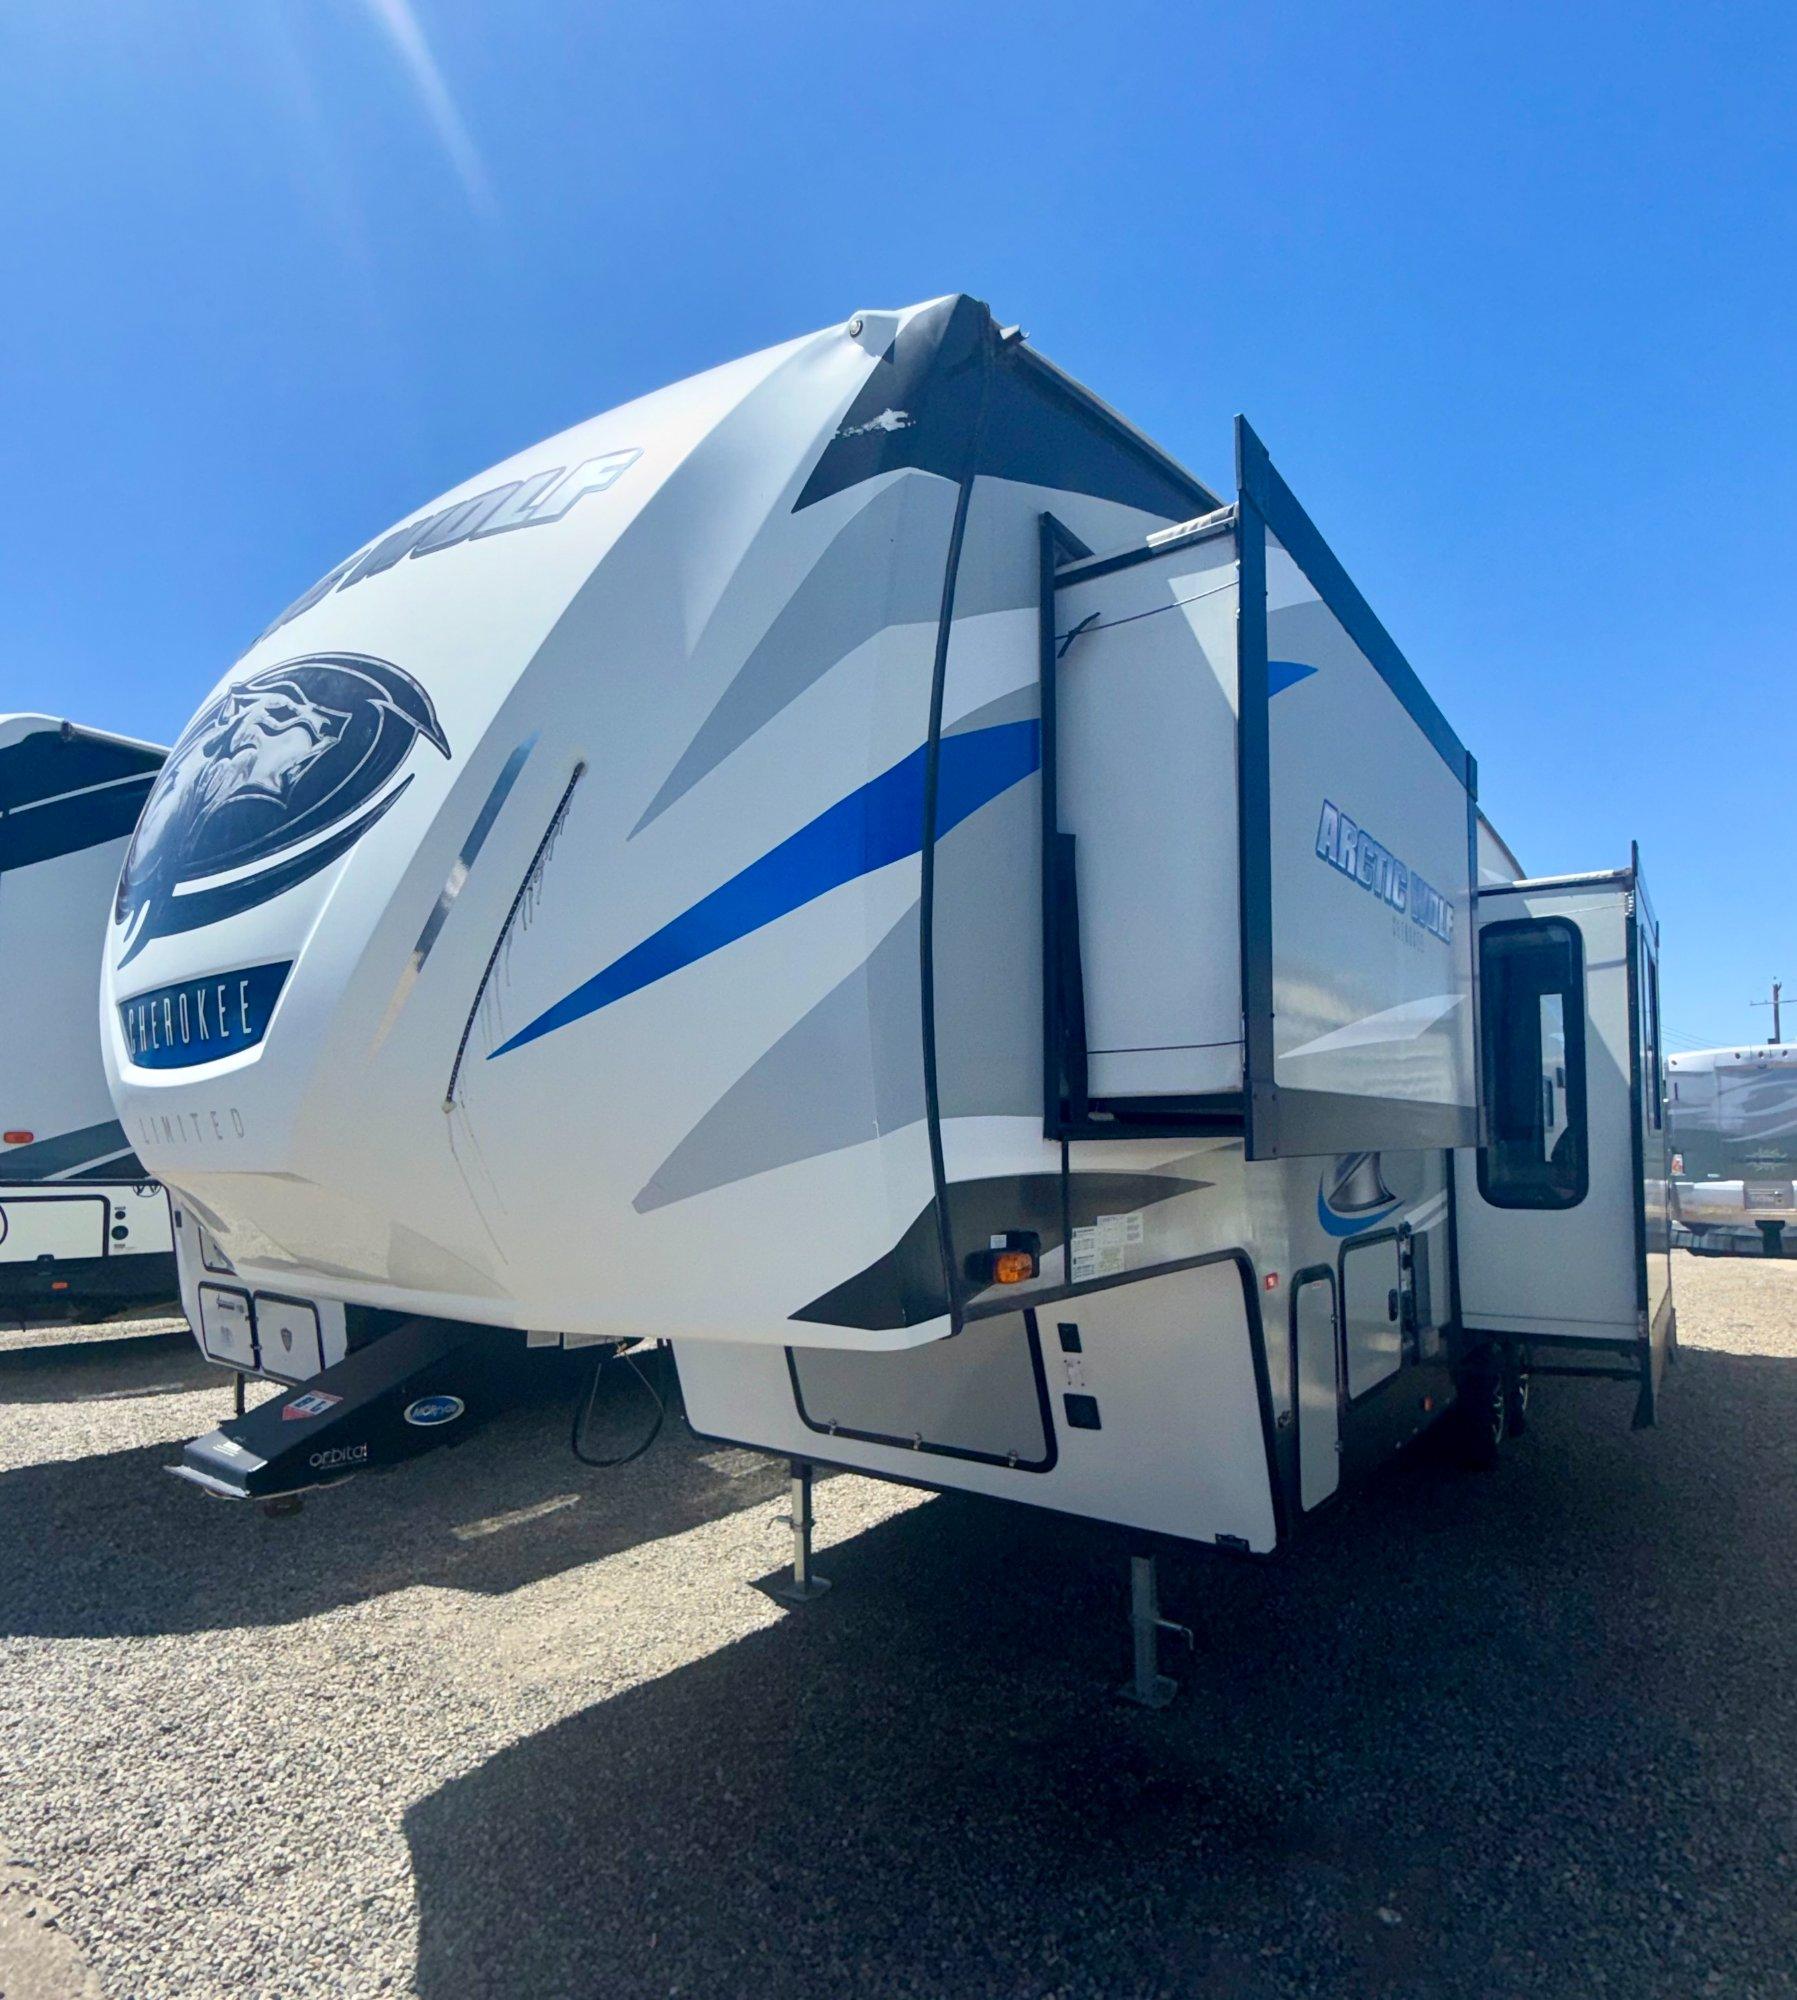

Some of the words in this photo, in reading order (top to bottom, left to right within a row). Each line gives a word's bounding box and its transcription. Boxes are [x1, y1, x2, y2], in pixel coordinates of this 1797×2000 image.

[1315, 798, 1407, 914] ARCTIC
[128, 980, 252, 1055] CHEROKEE
[138, 1107, 245, 1146] LIMITED
